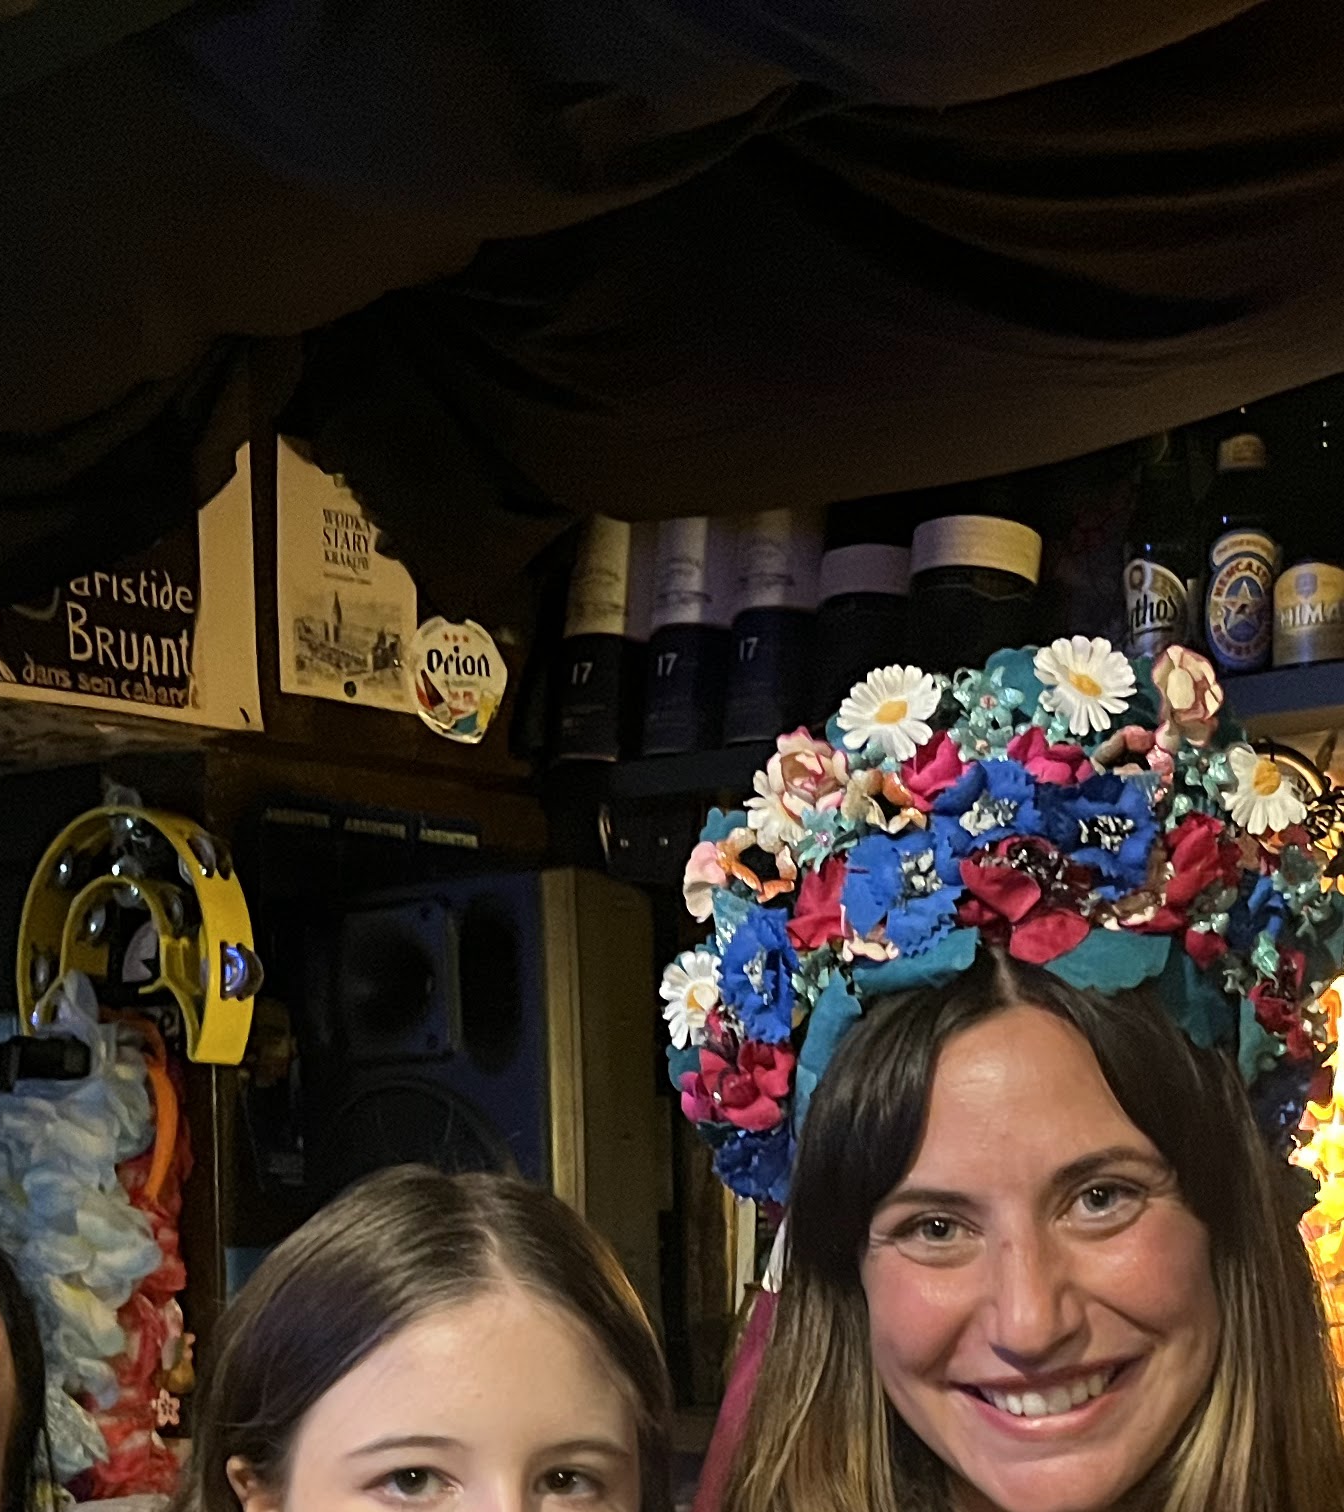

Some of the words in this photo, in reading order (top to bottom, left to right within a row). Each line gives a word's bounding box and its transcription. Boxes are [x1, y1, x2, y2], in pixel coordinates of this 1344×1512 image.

[68, 568, 196, 615] aristide
[427, 644, 491, 679] Orion
[738, 636, 760, 662] 17
[22, 651, 73, 690] dans
[77, 671, 118, 698] son
[570, 661, 594, 687] 17
[656, 652, 678, 678] 17
